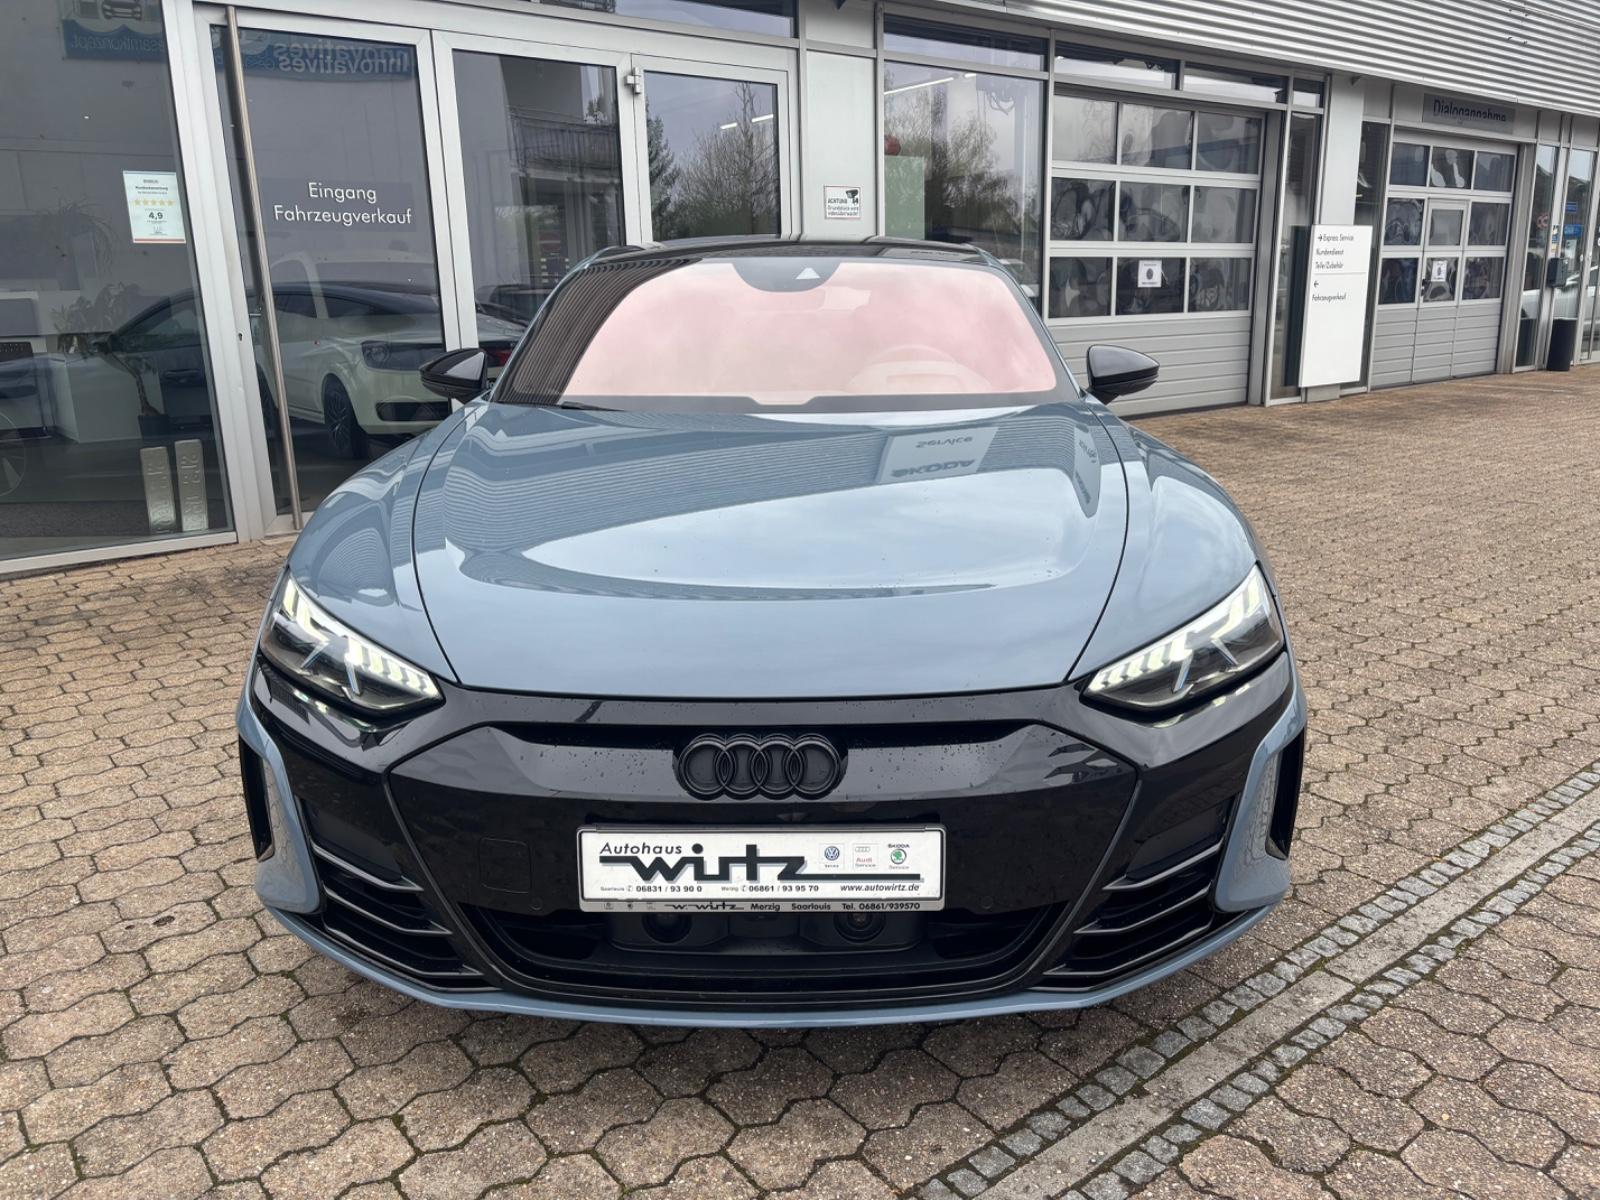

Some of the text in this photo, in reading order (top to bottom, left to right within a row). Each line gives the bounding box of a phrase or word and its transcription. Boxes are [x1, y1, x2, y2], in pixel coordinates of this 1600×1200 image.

[308, 182, 377, 204] Eingang
[148, 211, 163, 220] 4,9
[273, 204, 412, 227] Fahrzeugverkauf
[600, 842, 682, 855] Autohaus
[840, 883, 920, 892] www.autowirtz.de
[750, 903, 780, 911] Merzig
[791, 902, 831, 911] Saarlouis
[858, 902, 921, 910] 06861/939570
